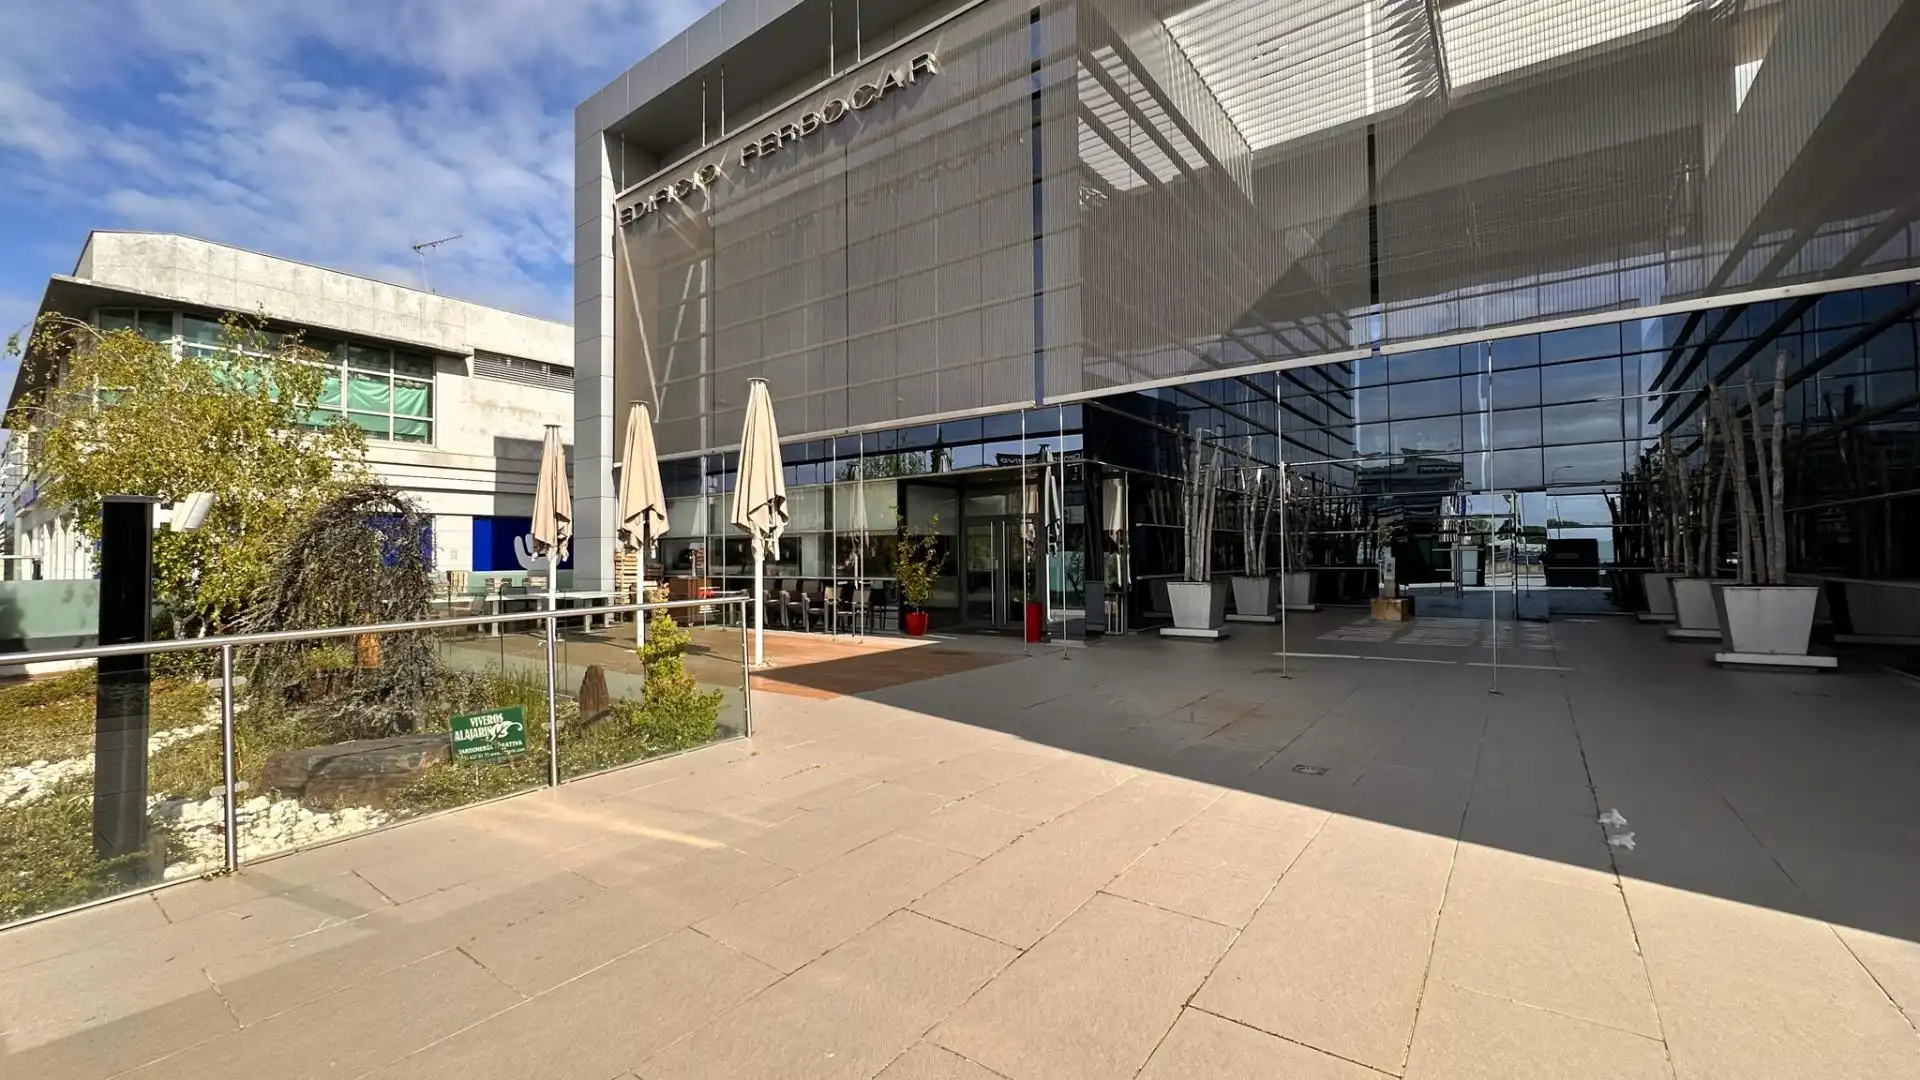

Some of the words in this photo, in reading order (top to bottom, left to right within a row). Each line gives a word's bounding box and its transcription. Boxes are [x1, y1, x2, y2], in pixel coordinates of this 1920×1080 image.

[618, 163, 721, 227] EDIFICIO
[740, 51, 938, 168] FERBOCAR
[469, 713, 504, 727] VIVEROS
